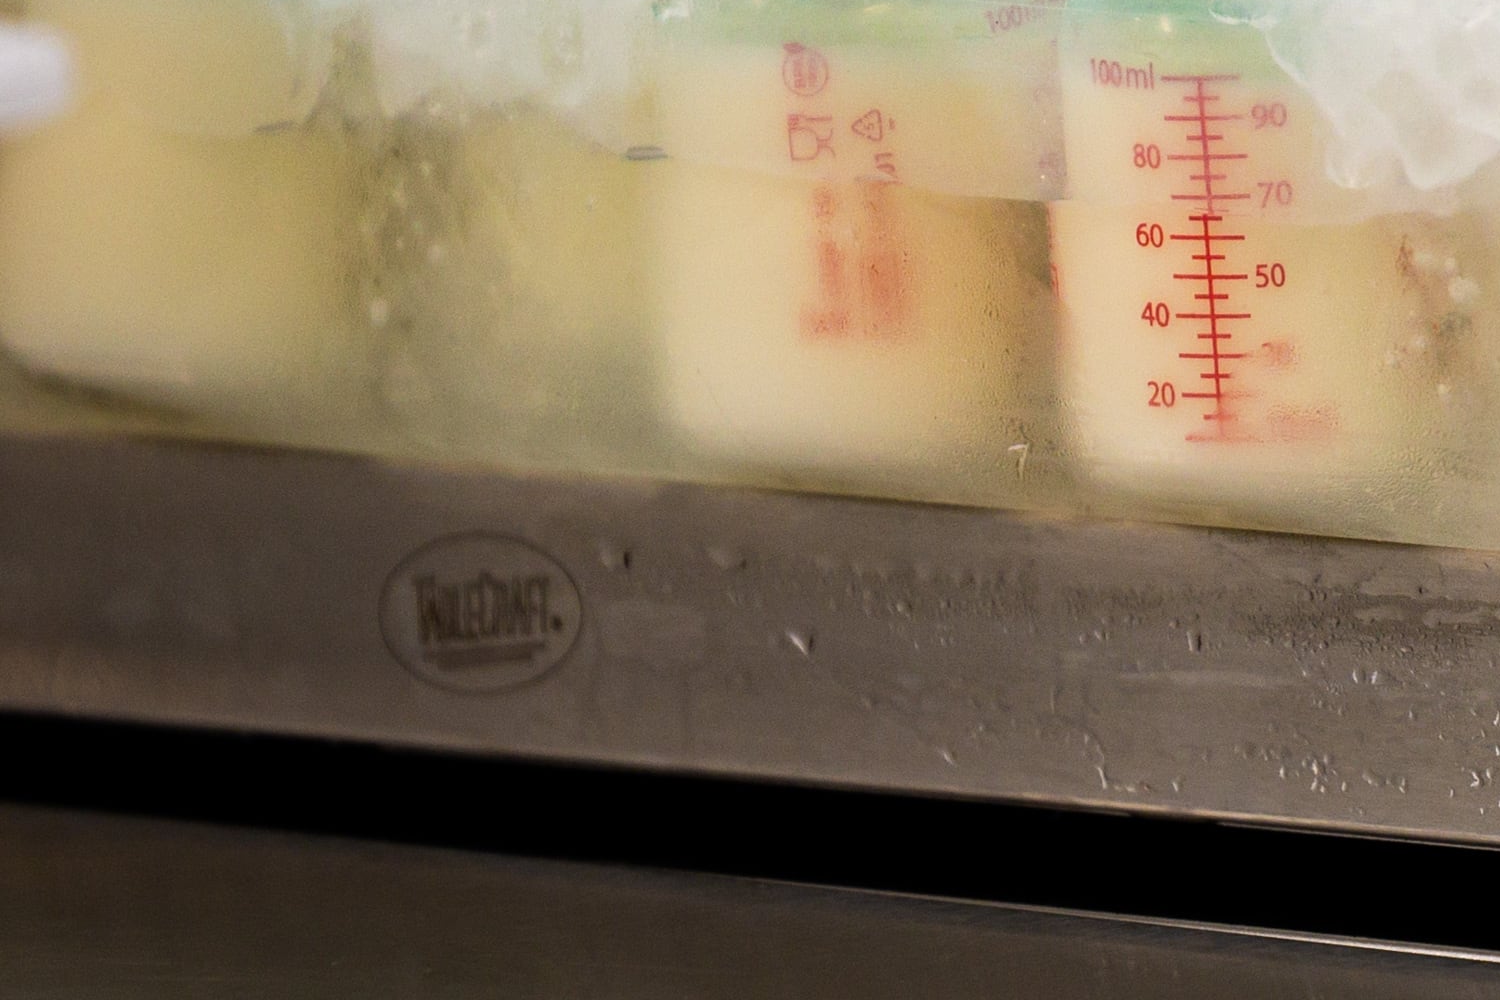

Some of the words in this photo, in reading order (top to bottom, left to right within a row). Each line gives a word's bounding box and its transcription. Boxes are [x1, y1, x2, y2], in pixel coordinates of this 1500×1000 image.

[1250, 102, 1287, 129] 90
[1133, 143, 1161, 169] 80
[1256, 179, 1293, 209] 70
[1135, 222, 1164, 248] 60
[1255, 263, 1286, 288] 50
[1140, 302, 1170, 327] 40
[1147, 381, 1176, 407] 20
